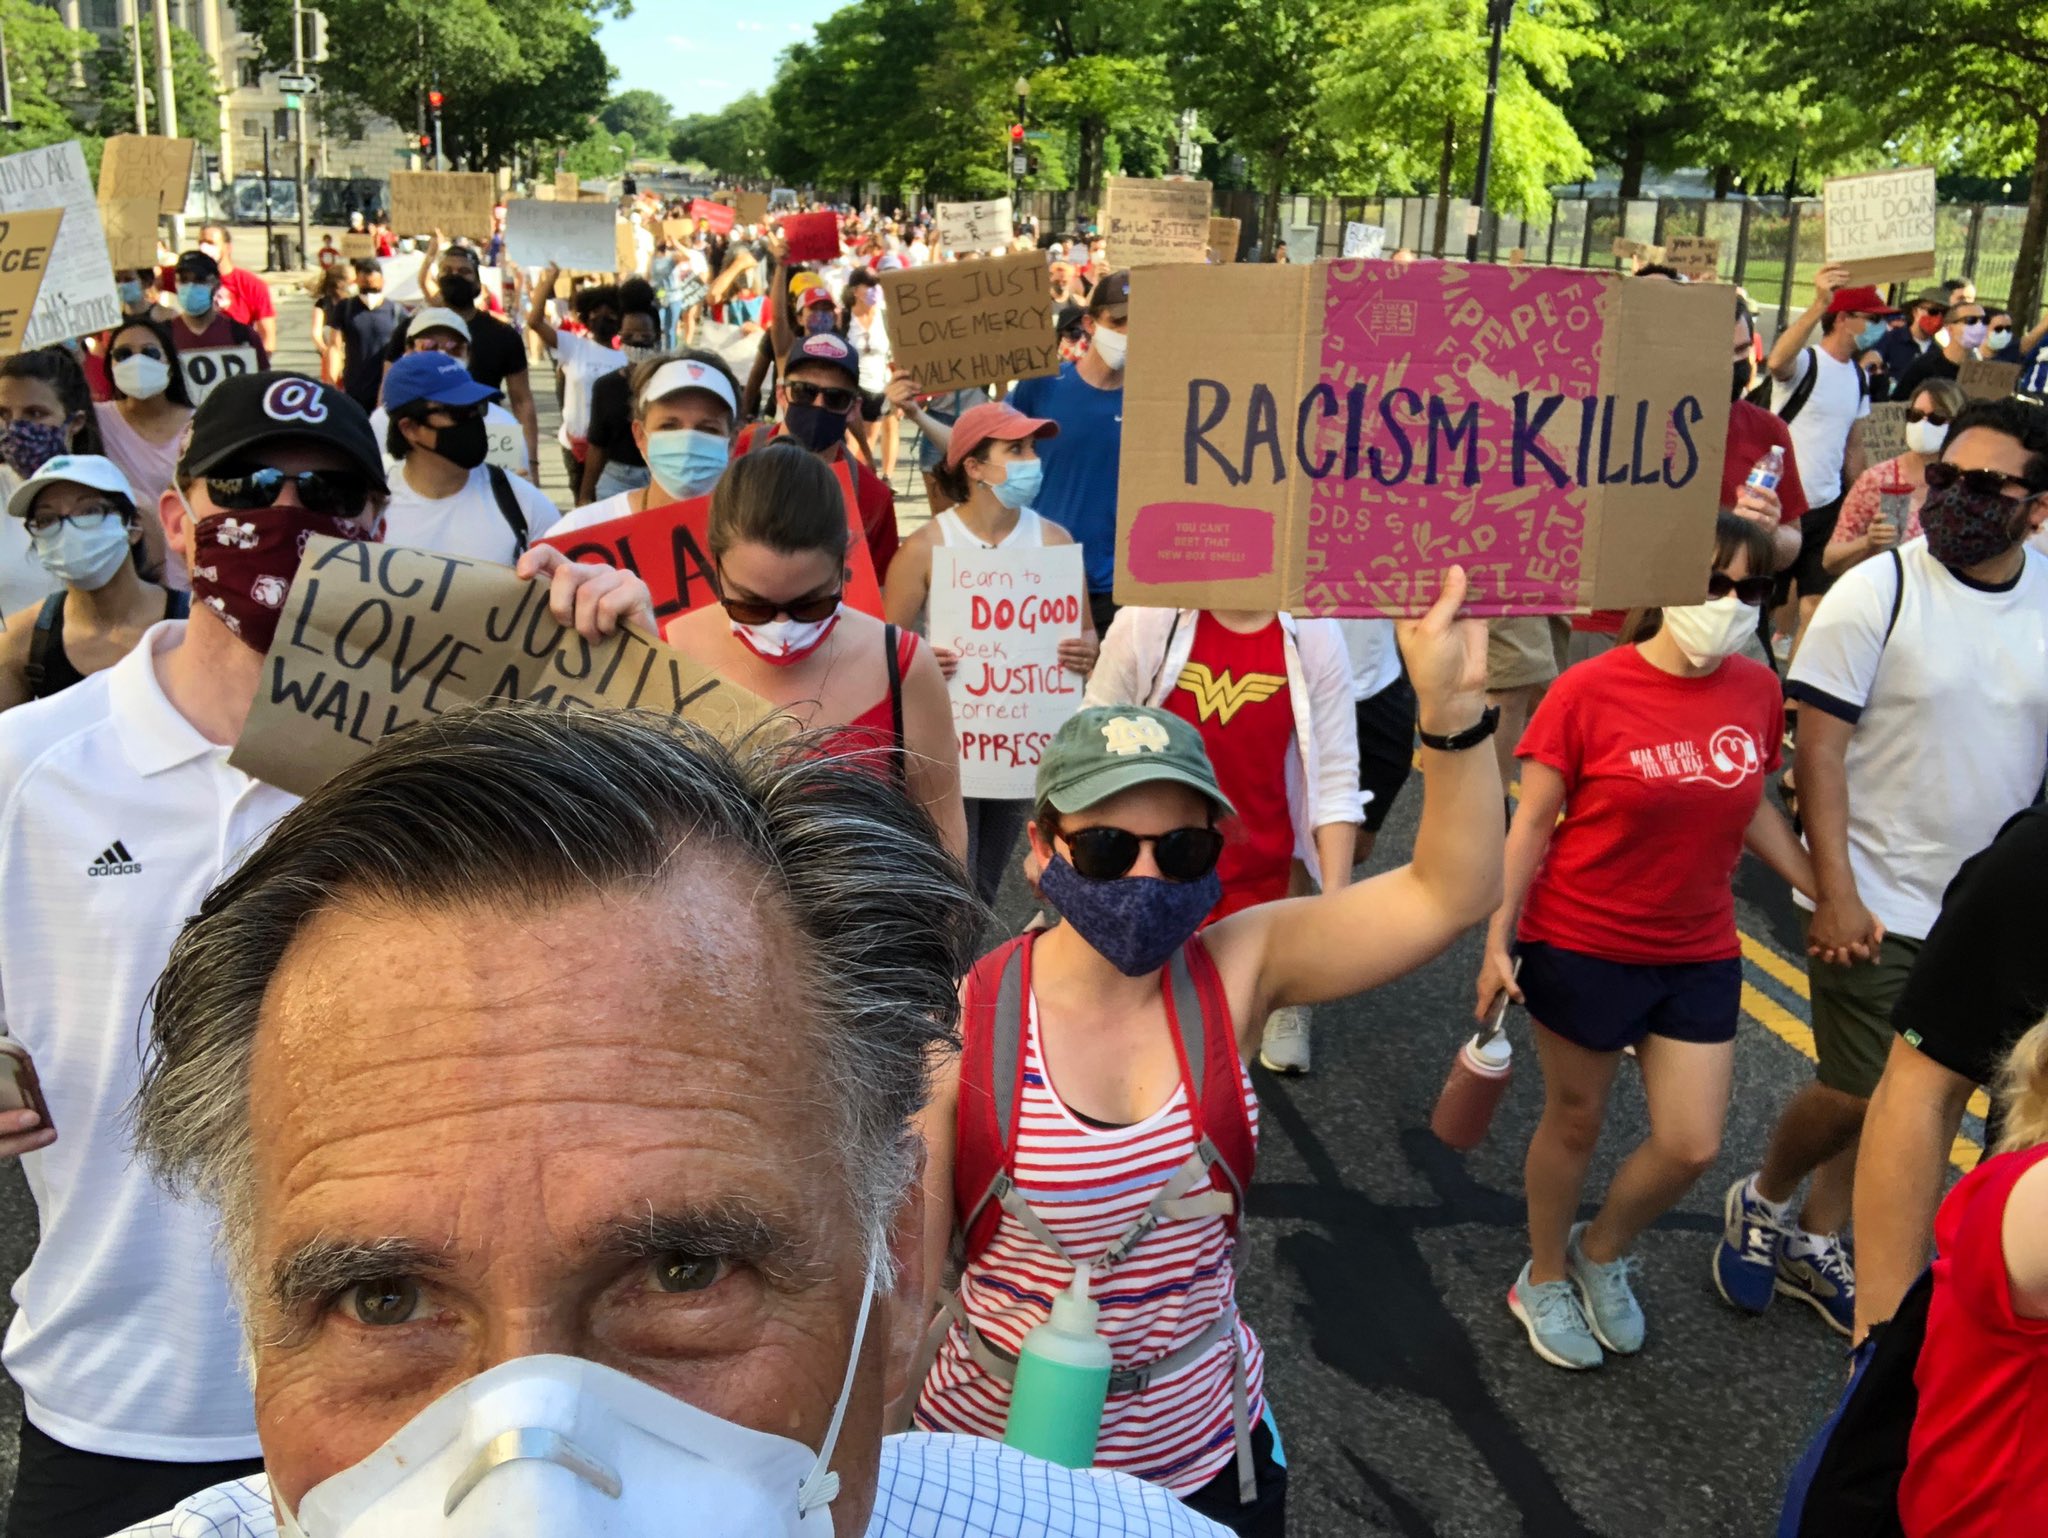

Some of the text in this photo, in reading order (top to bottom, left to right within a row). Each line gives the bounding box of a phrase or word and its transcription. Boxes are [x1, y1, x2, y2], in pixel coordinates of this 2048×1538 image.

[1829, 173, 1931, 204] LET JUSTICE
[1829, 195, 1933, 226] ROLL DOWN
[1151, 219, 1201, 236] JUSTICE
[1829, 214, 1933, 248] LIKE WATERS
[0, 247, 46, 272] CE
[895, 265, 1044, 316] BE JUST
[897, 306, 1048, 348] LOVE MERCY
[1372, 303, 1384, 332] THIS
[1385, 303, 1399, 333] SIDE
[1399, 304, 1413, 332] UP
[971, 345, 1054, 380] HUMBLY
[1184, 378, 1481, 487] RACISM
[1511, 393, 1704, 489] KILLS
[1176, 522, 1231, 534] YOU CAN'T
[1204, 537, 1230, 547] THAT
[1158, 550, 1181, 560] NEW
[1185, 550, 1206, 561] BOX
[310, 540, 474, 612] ACT
[952, 558, 1042, 589] learn to
[971, 595, 1079, 635] DO GOOD
[292, 578, 484, 714] LOVE
[965, 661, 1075, 697] JUSTICE
[1656, 743, 1671, 762] THE
[1663, 757, 1680, 775] THE
[88, 862, 142, 877] adidas
